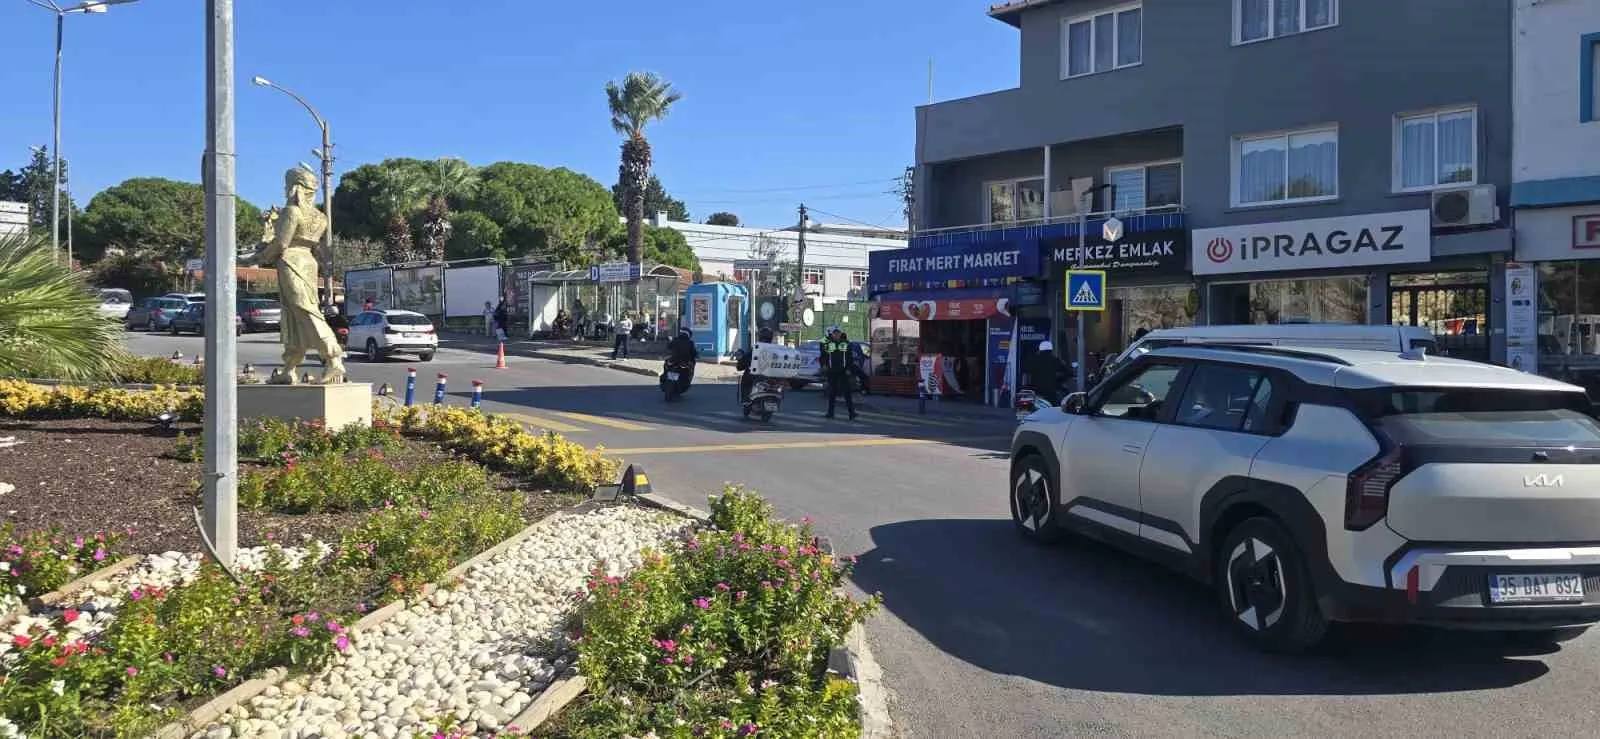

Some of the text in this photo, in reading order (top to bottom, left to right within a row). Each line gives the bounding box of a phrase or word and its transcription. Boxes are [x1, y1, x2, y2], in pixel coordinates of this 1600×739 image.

[1119, 240, 1174, 258] EMLAK
[888, 251, 1021, 273] FIRAT MERT MARKET
[591, 266, 599, 281] D
[1500, 576, 1582, 595] 35 DAY 892
